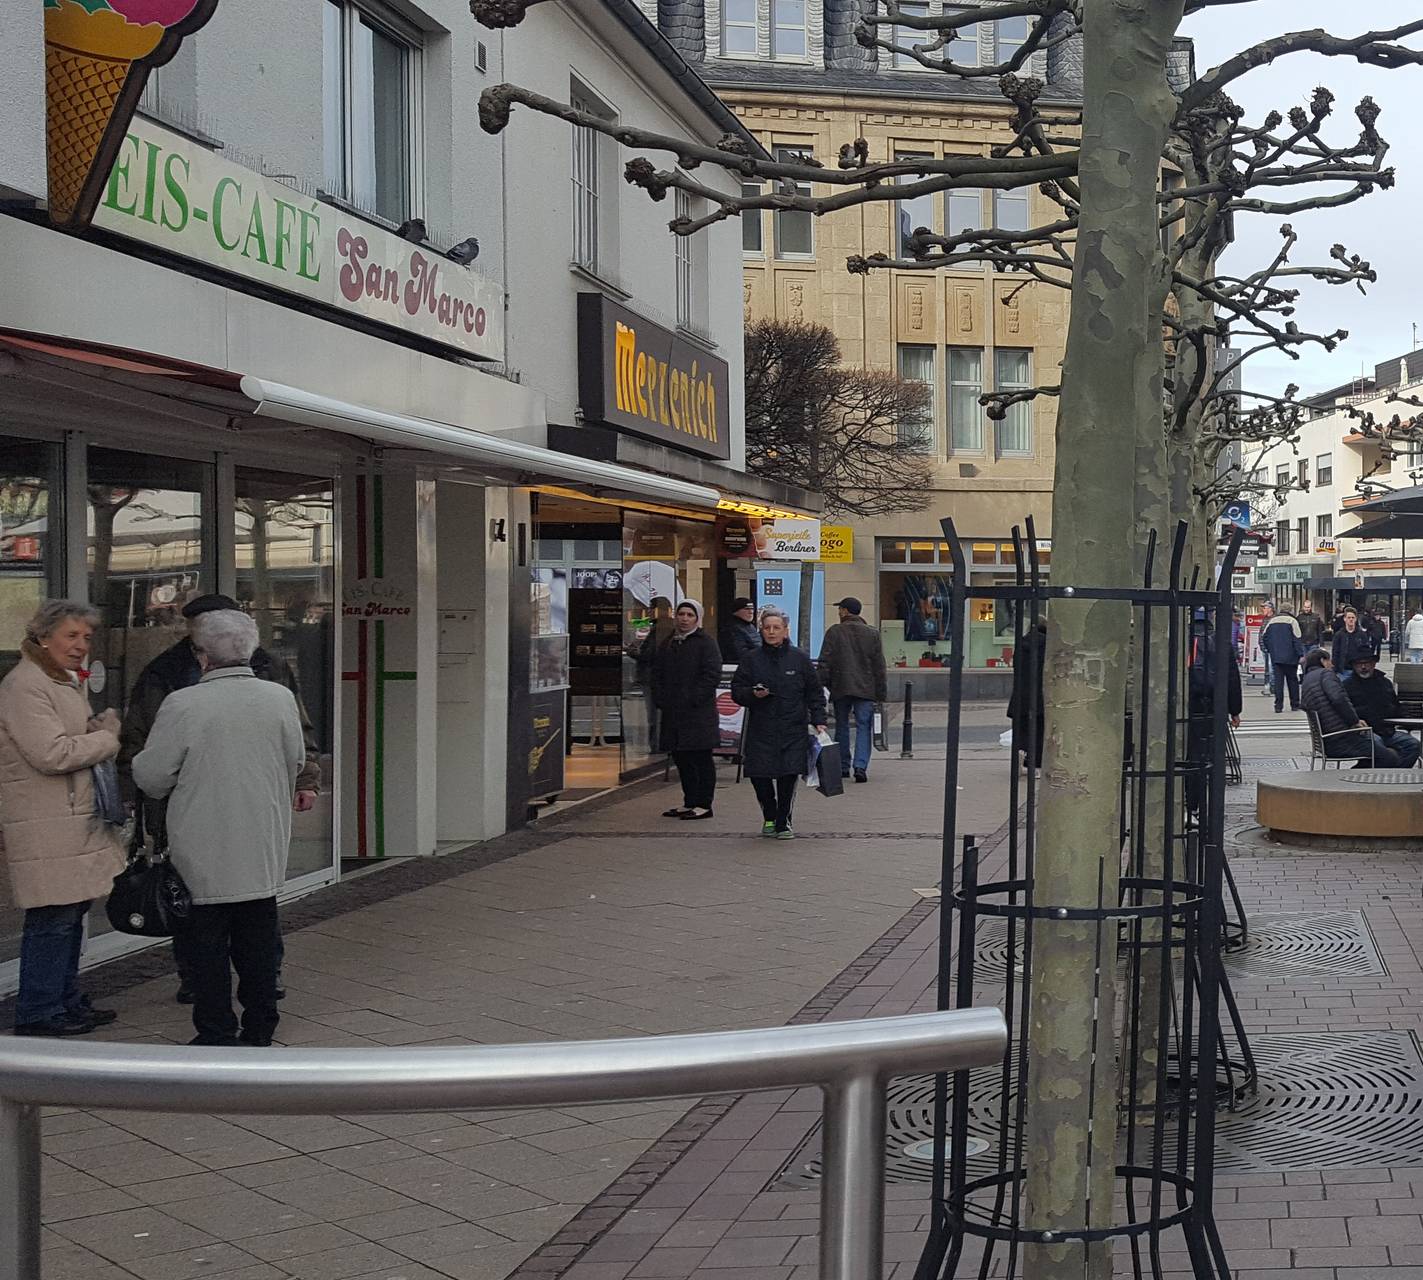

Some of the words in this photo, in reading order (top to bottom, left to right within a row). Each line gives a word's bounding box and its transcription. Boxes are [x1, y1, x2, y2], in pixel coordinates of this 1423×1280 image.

[101, 133, 321, 282] EIS-CAFÉ
[336, 227, 400, 302] San
[403, 251, 487, 337] Marco
[615, 320, 718, 443] Merzenich
[774, 540, 817, 553] Berliner
[820, 539, 844, 549] ogo
[1319, 539, 1334, 548] dm
[365, 601, 411, 616] Marco
